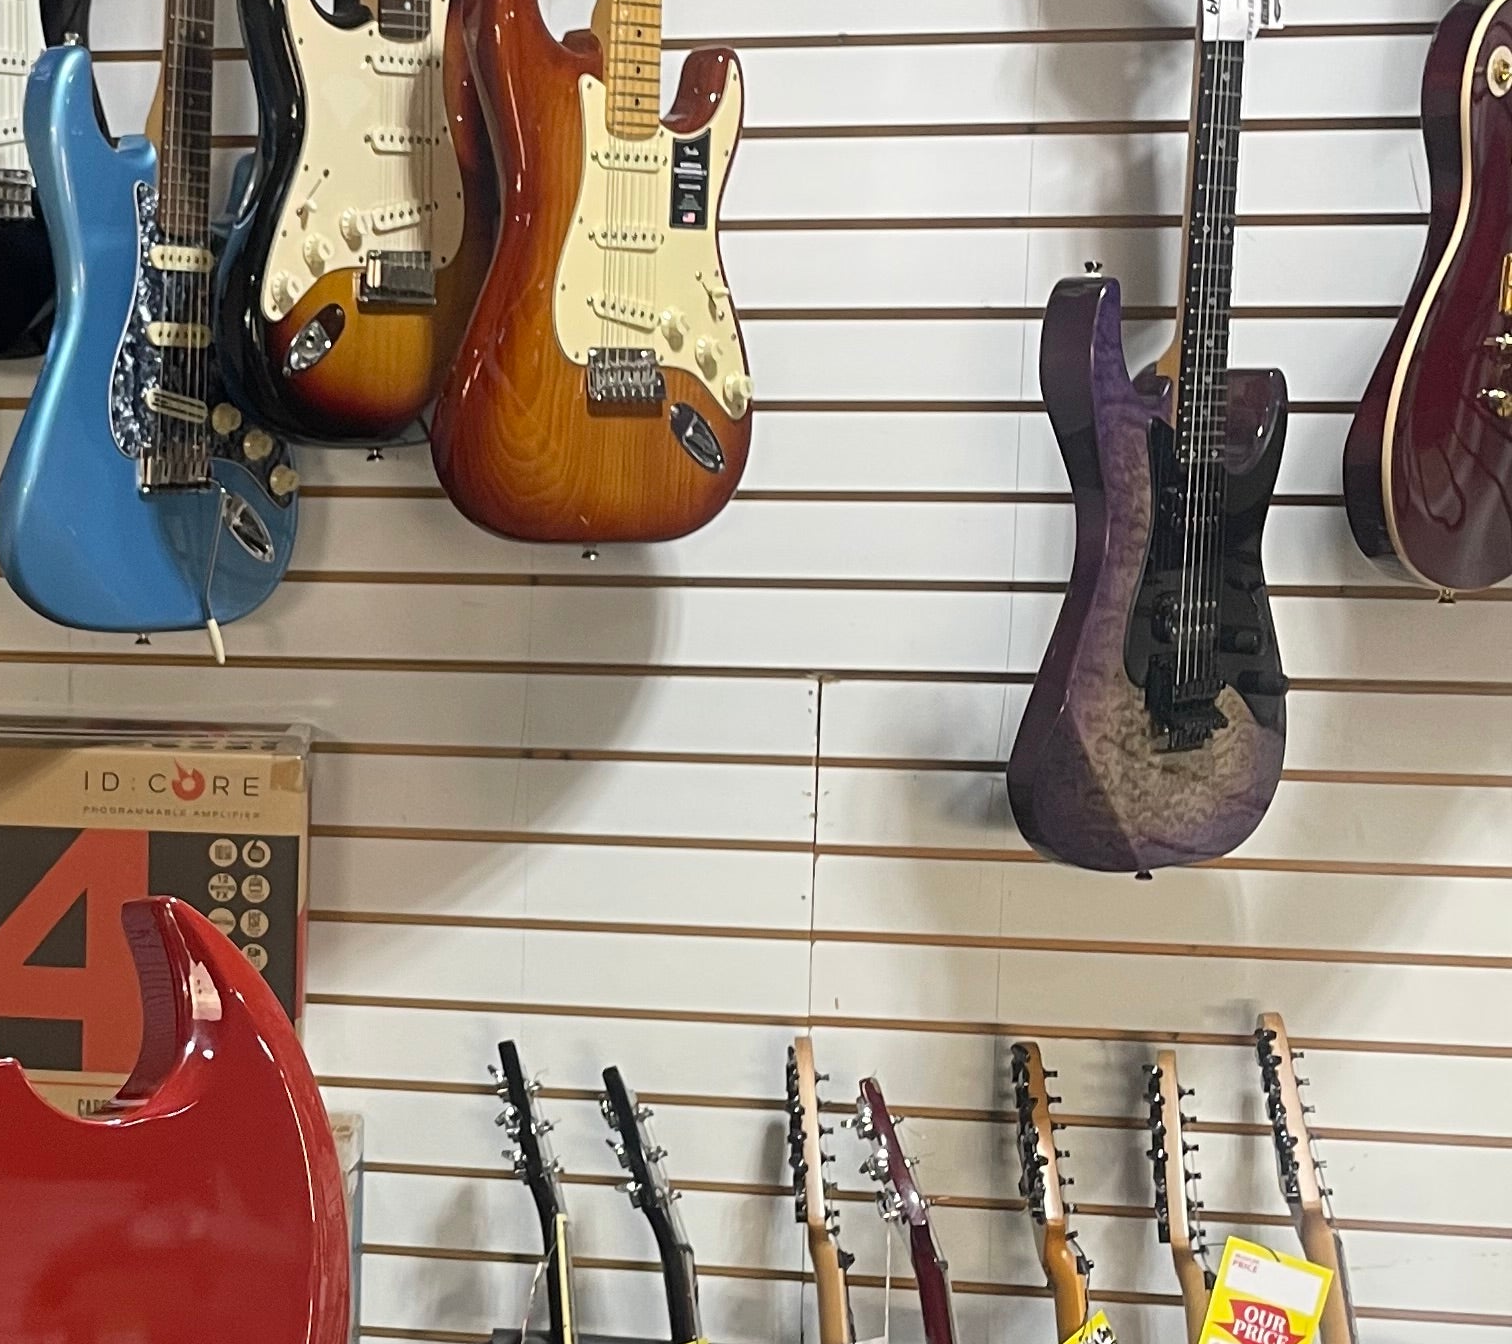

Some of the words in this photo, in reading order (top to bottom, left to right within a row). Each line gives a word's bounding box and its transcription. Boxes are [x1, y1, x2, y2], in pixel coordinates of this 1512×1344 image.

[82, 805, 187, 817] PROGRAMMABLE
[192, 810, 262, 820] AMPLIFIER
[1243, 1305, 1287, 1333] OUR
